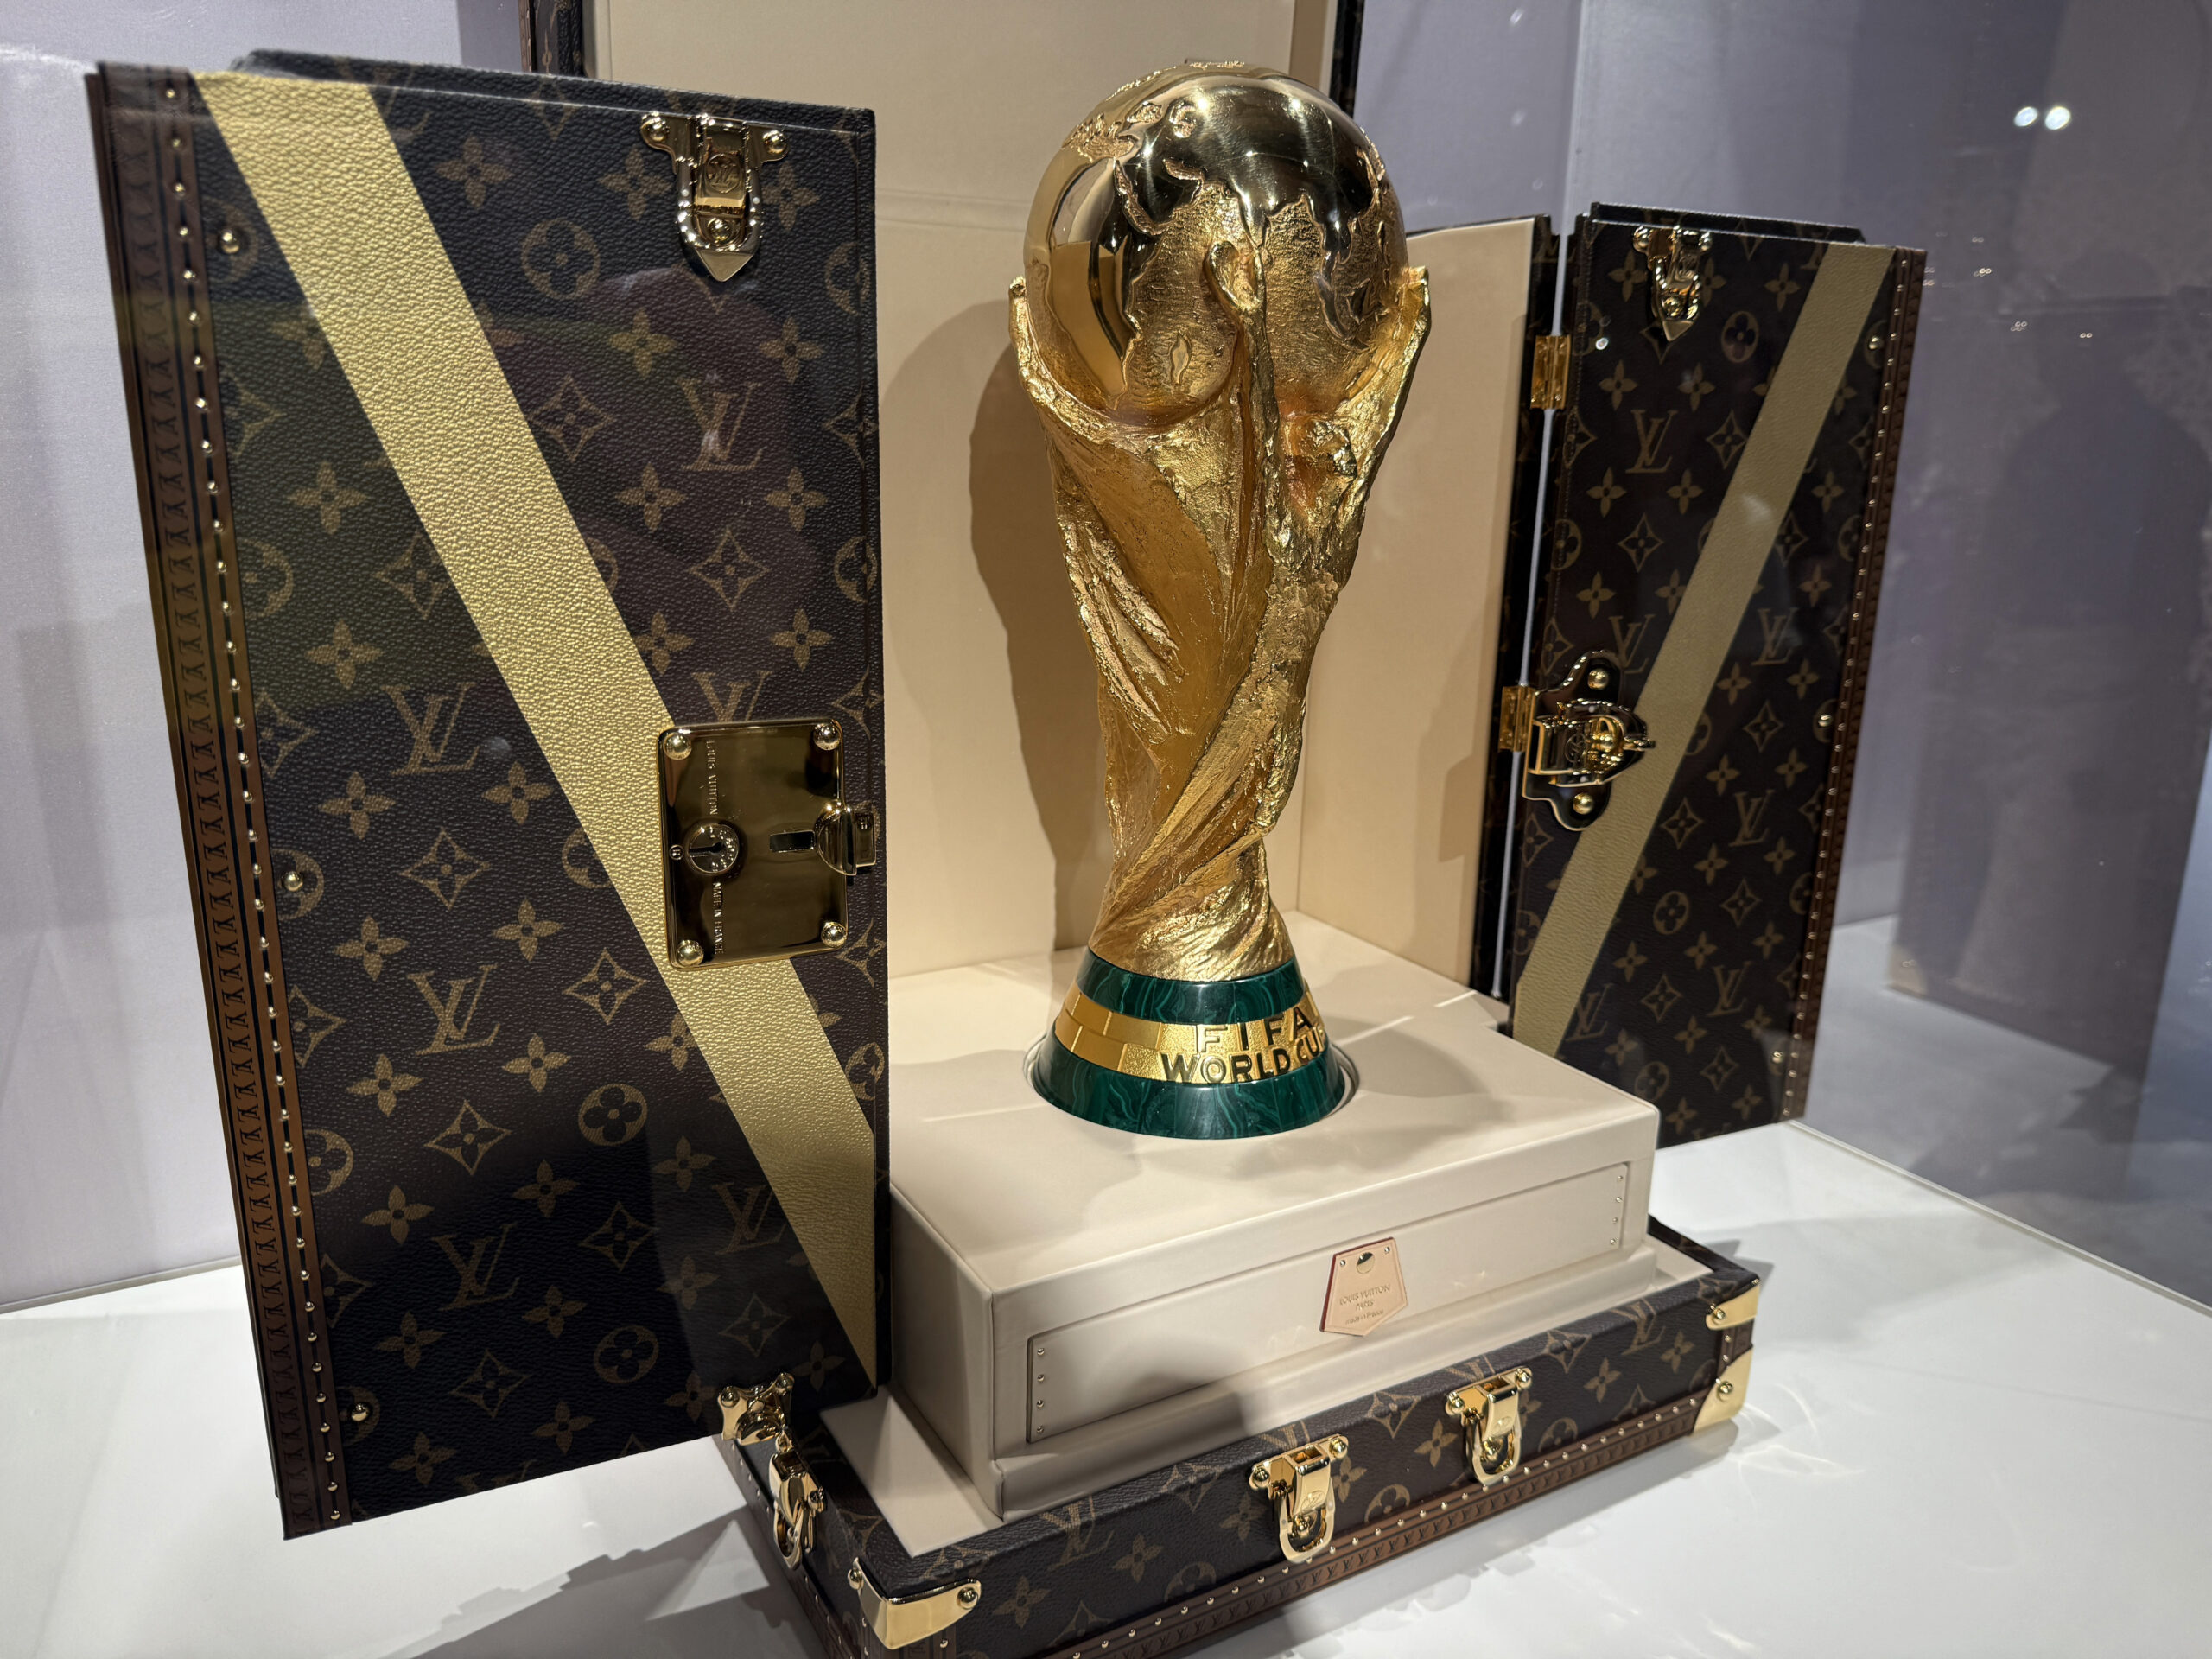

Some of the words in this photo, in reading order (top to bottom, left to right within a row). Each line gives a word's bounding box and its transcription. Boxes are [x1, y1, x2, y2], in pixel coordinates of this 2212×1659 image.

[381, 682, 480, 776] LV
[407, 964, 501, 1056] LV
[1195, 1006, 1313, 1052] FIFA
[1161, 1047, 1292, 1084] WORLD
[1339, 1292, 1359, 1306] LOUIS
[1360, 1283, 1390, 1298] VUITTON
[1356, 1299, 1374, 1311] PARIS
